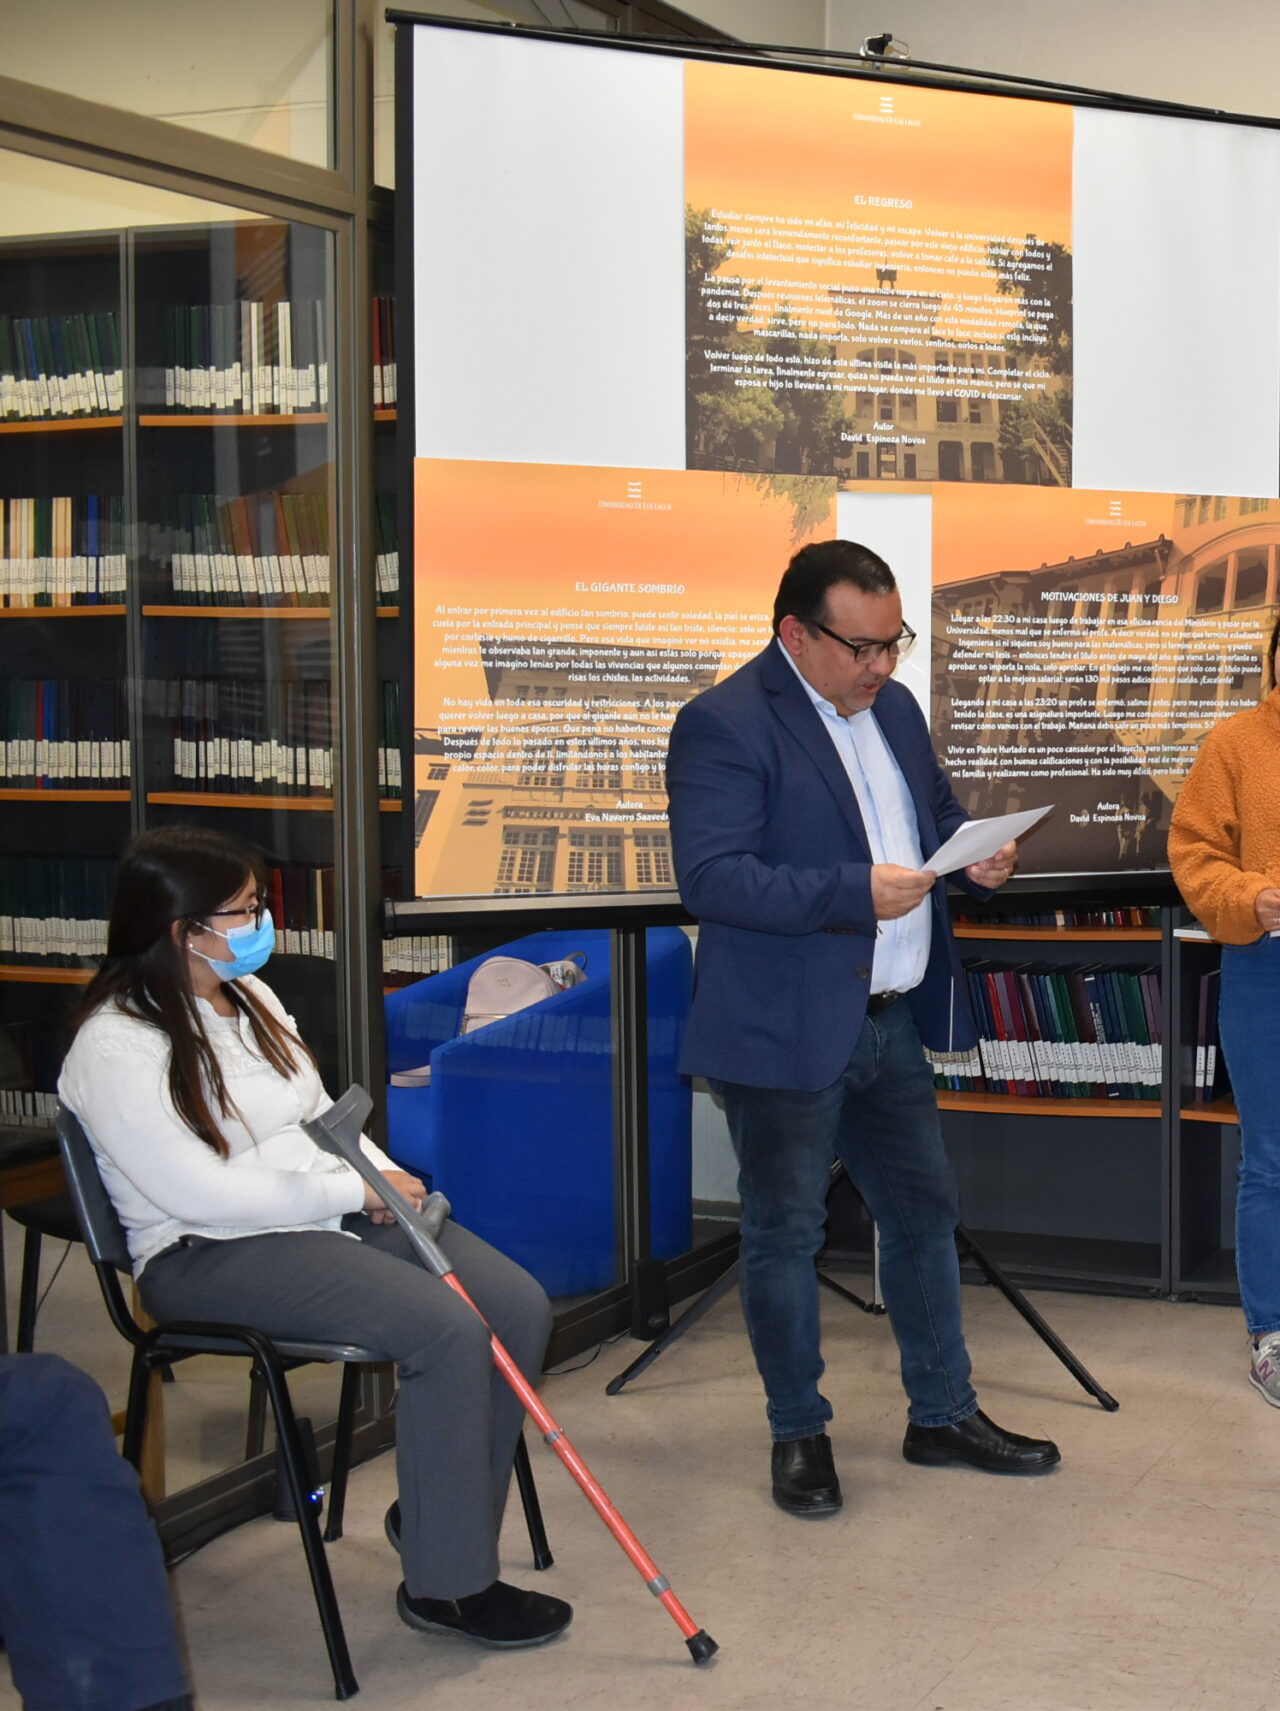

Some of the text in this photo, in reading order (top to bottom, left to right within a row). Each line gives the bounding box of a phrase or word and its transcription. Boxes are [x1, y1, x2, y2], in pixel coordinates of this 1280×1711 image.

[855, 196, 912, 208] EL REGRESO
[704, 350, 730, 359] Volver
[732, 352, 752, 363] luego
[755, 353, 764, 361] de
[766, 354, 783, 362] todo
[804, 356, 819, 364] hizo
[822, 357, 831, 365] de
[832, 358, 847, 366] esta
[873, 360, 893, 369] visita
[903, 362, 917, 370] más
[919, 363, 957, 375] importante
[958, 367, 974, 376] para
[988, 367, 1023, 379] Completar
[735, 380, 761, 389] esposa
[769, 379, 783, 390] hijo
[794, 380, 824, 390] llevarán
[833, 382, 842, 390] mi
[890, 385, 912, 394] donde
[946, 388, 952, 396] el
[954, 389, 980, 398] COVID
[987, 390, 1023, 400] descansar.
[873, 422, 894, 430] Autor
[841, 433, 925, 445] David Espinoza Novoa
[575, 582, 588, 592] EL
[591, 583, 635, 593] GIGANTE
[1041, 592, 1178, 603] MOTIVACIONES DE JUAN Y DIEGO
[645, 674, 690, 682] actividades.
[978, 674, 997, 684] optar
[1012, 674, 1035, 685] mejora
[443, 738, 478, 748] Después
[523, 737, 552, 748] pasado
[1117, 744, 1144, 754] trayecto,
[444, 750, 472, 760] propio
[474, 750, 504, 760] espacio
[1111, 755, 1146, 766] posibilidad
[1051, 768, 1089, 778] profesional.
[1093, 813, 1123, 824] Espinoza
